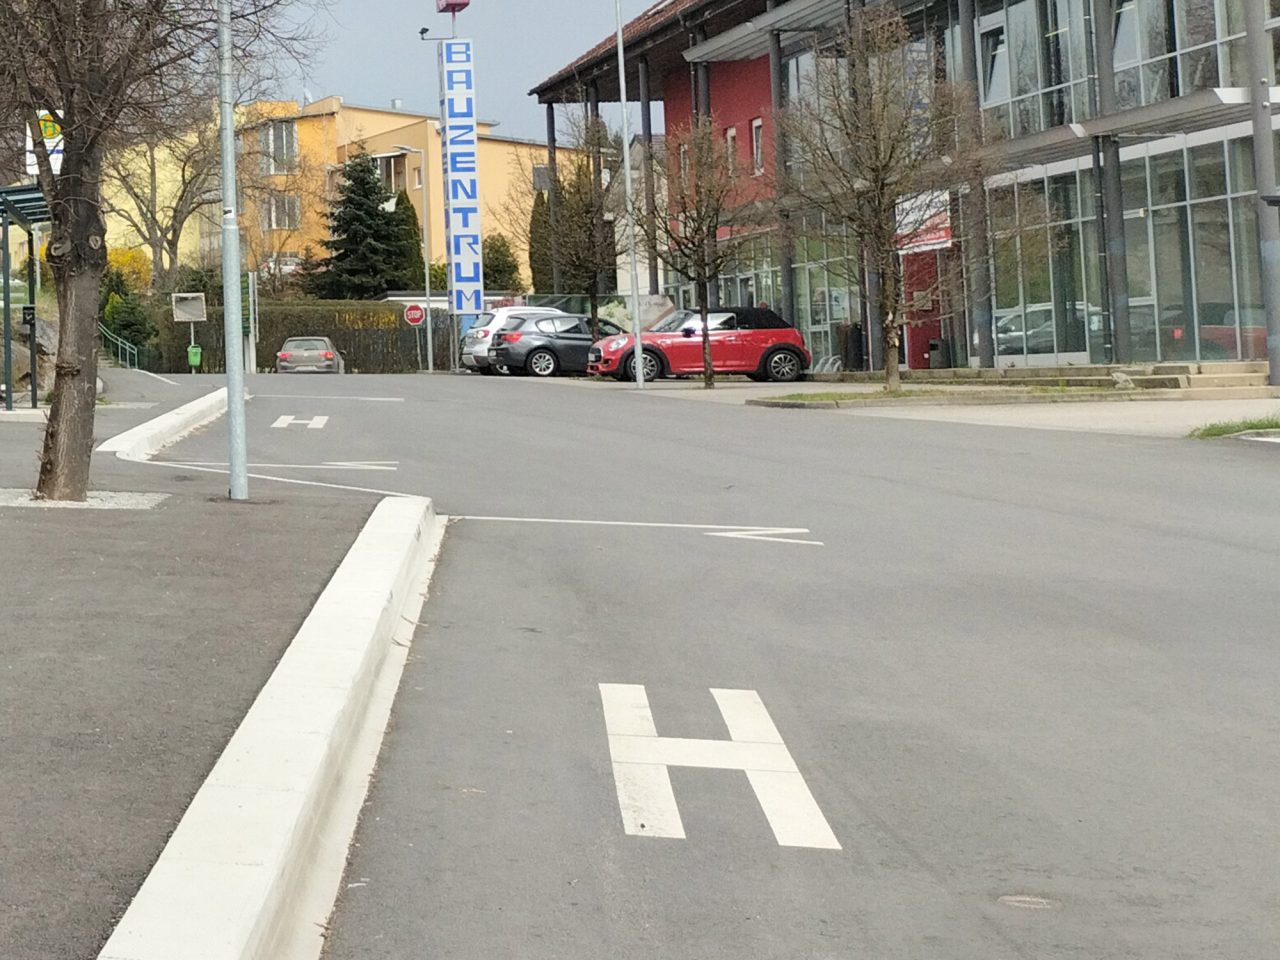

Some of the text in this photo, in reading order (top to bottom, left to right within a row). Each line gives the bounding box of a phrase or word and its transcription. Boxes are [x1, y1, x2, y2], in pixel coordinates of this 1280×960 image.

[445, 42, 482, 314] BAUZENTRUM
[407, 311, 422, 319] STOP
[598, 683, 843, 850] H
